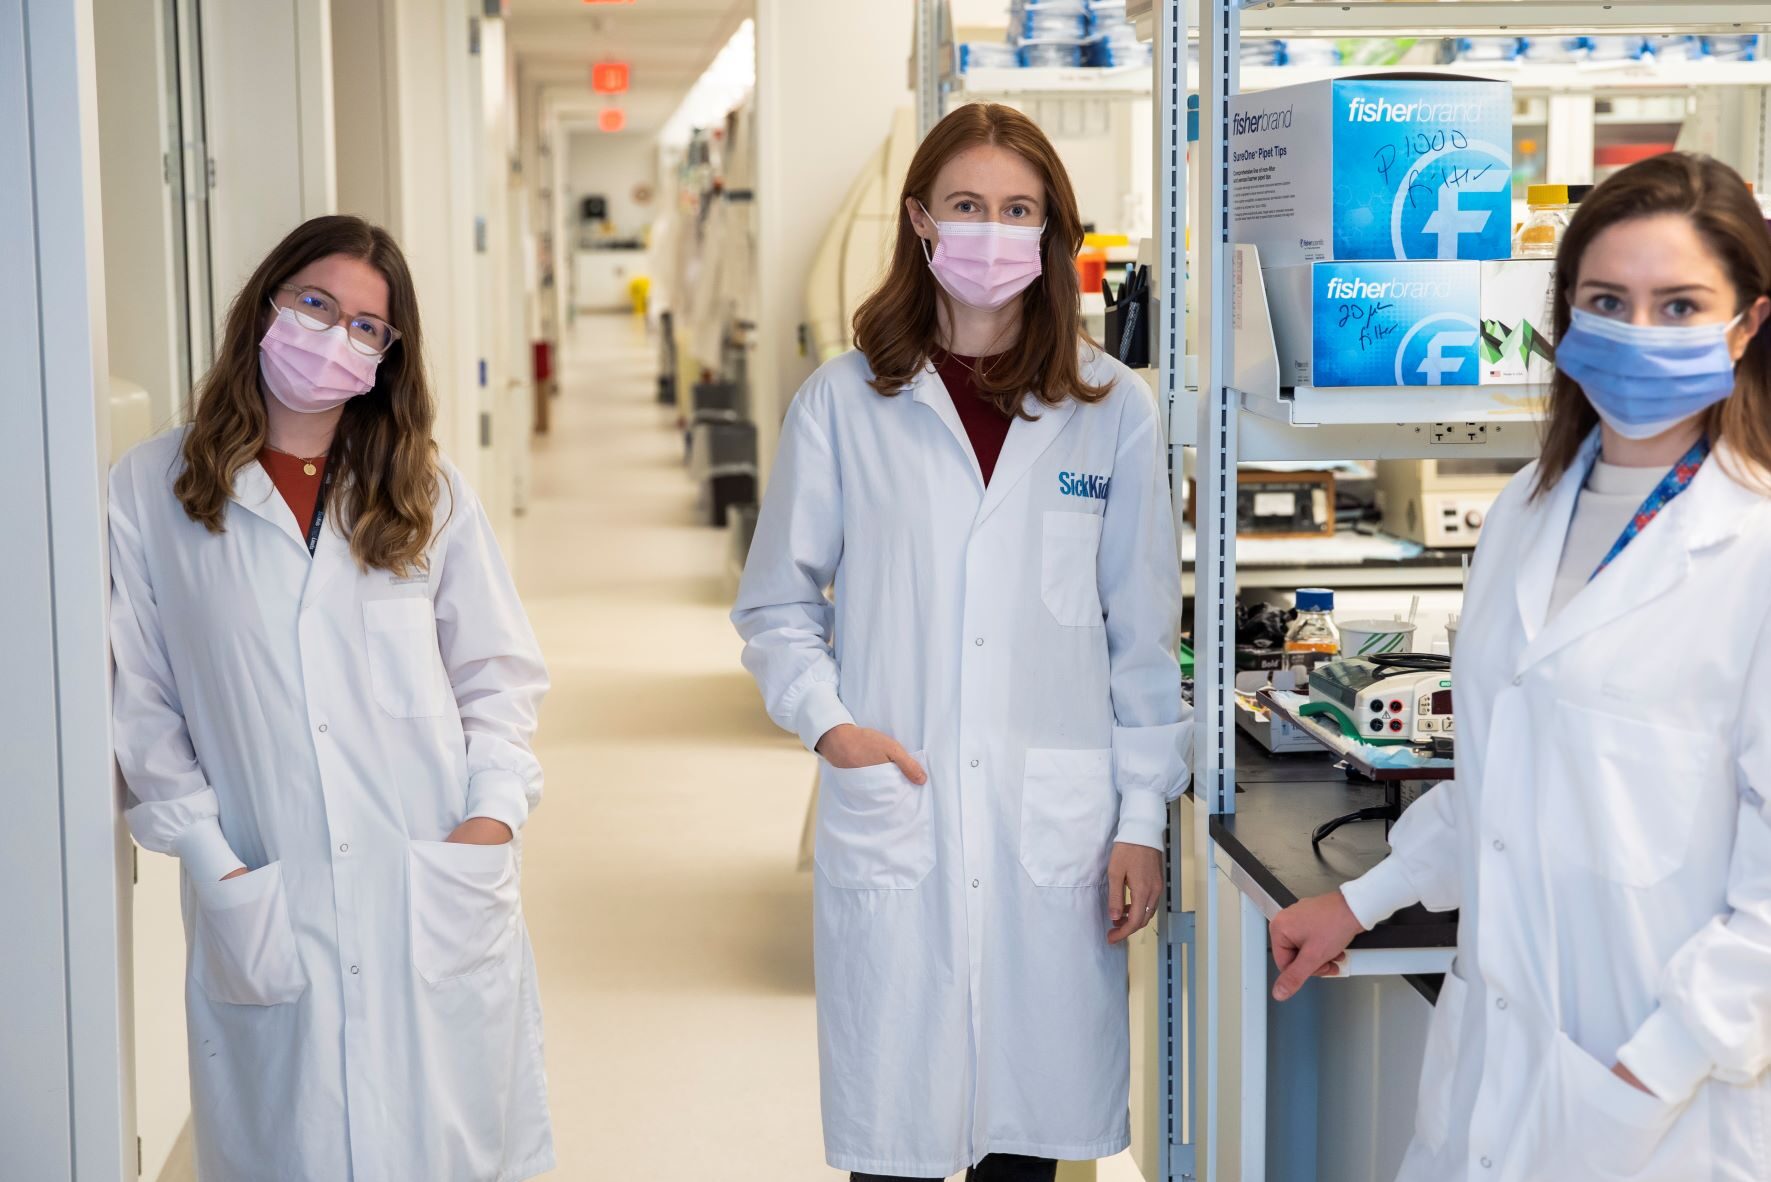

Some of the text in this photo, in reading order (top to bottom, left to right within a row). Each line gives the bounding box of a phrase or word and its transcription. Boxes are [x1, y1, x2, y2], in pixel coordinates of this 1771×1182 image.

[1233, 104, 1294, 136] fisherbrand
[1348, 97, 1482, 122] fisherbrand
[1258, 147, 1273, 160] Pipet
[1274, 145, 1287, 158] Tips
[1327, 277, 1452, 299] fisherbrand
[1339, 304, 1364, 328] 20
